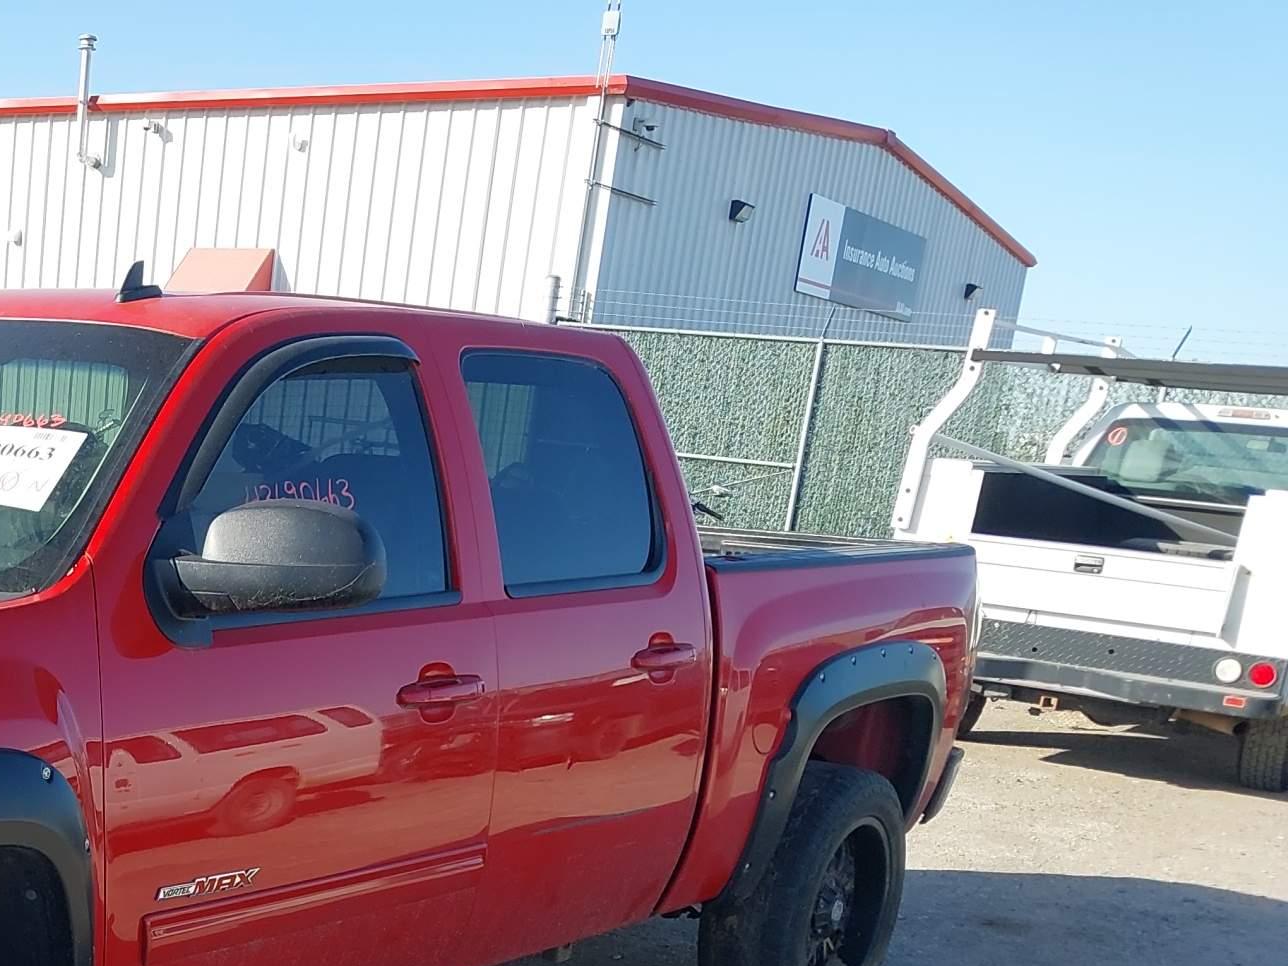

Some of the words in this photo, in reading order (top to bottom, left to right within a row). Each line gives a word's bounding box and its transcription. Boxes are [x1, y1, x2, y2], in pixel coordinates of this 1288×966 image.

[843, 240, 875, 269] Insurance
[873, 251, 890, 273] Auto
[889, 256, 916, 282] Auctions
[163, 886, 191, 898] VORTEC
[193, 868, 260, 895] MAX
